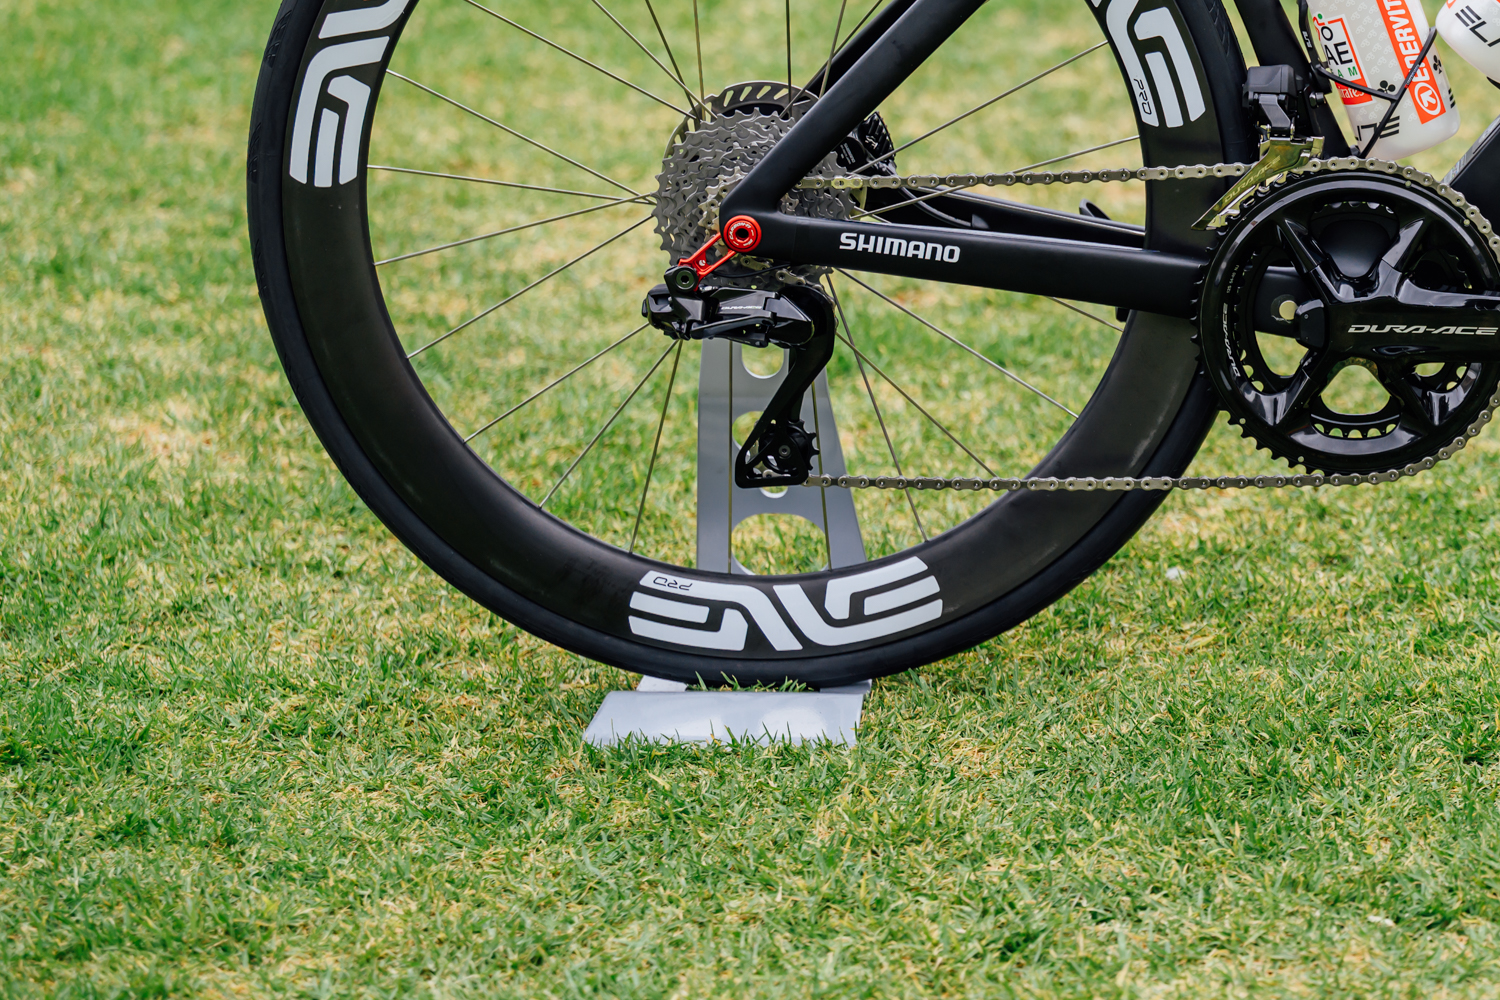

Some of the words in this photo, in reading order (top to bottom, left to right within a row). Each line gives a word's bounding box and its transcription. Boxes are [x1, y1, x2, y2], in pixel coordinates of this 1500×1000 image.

[1324, 41, 1353, 66] AE
[1133, 77, 1152, 116] PRO
[1224, 155, 1280, 203] DURA-ACE
[839, 232, 960, 263] SHIMANO
[1347, 324, 1499, 335] DURA-ACE
[652, 576, 693, 591] PRO
